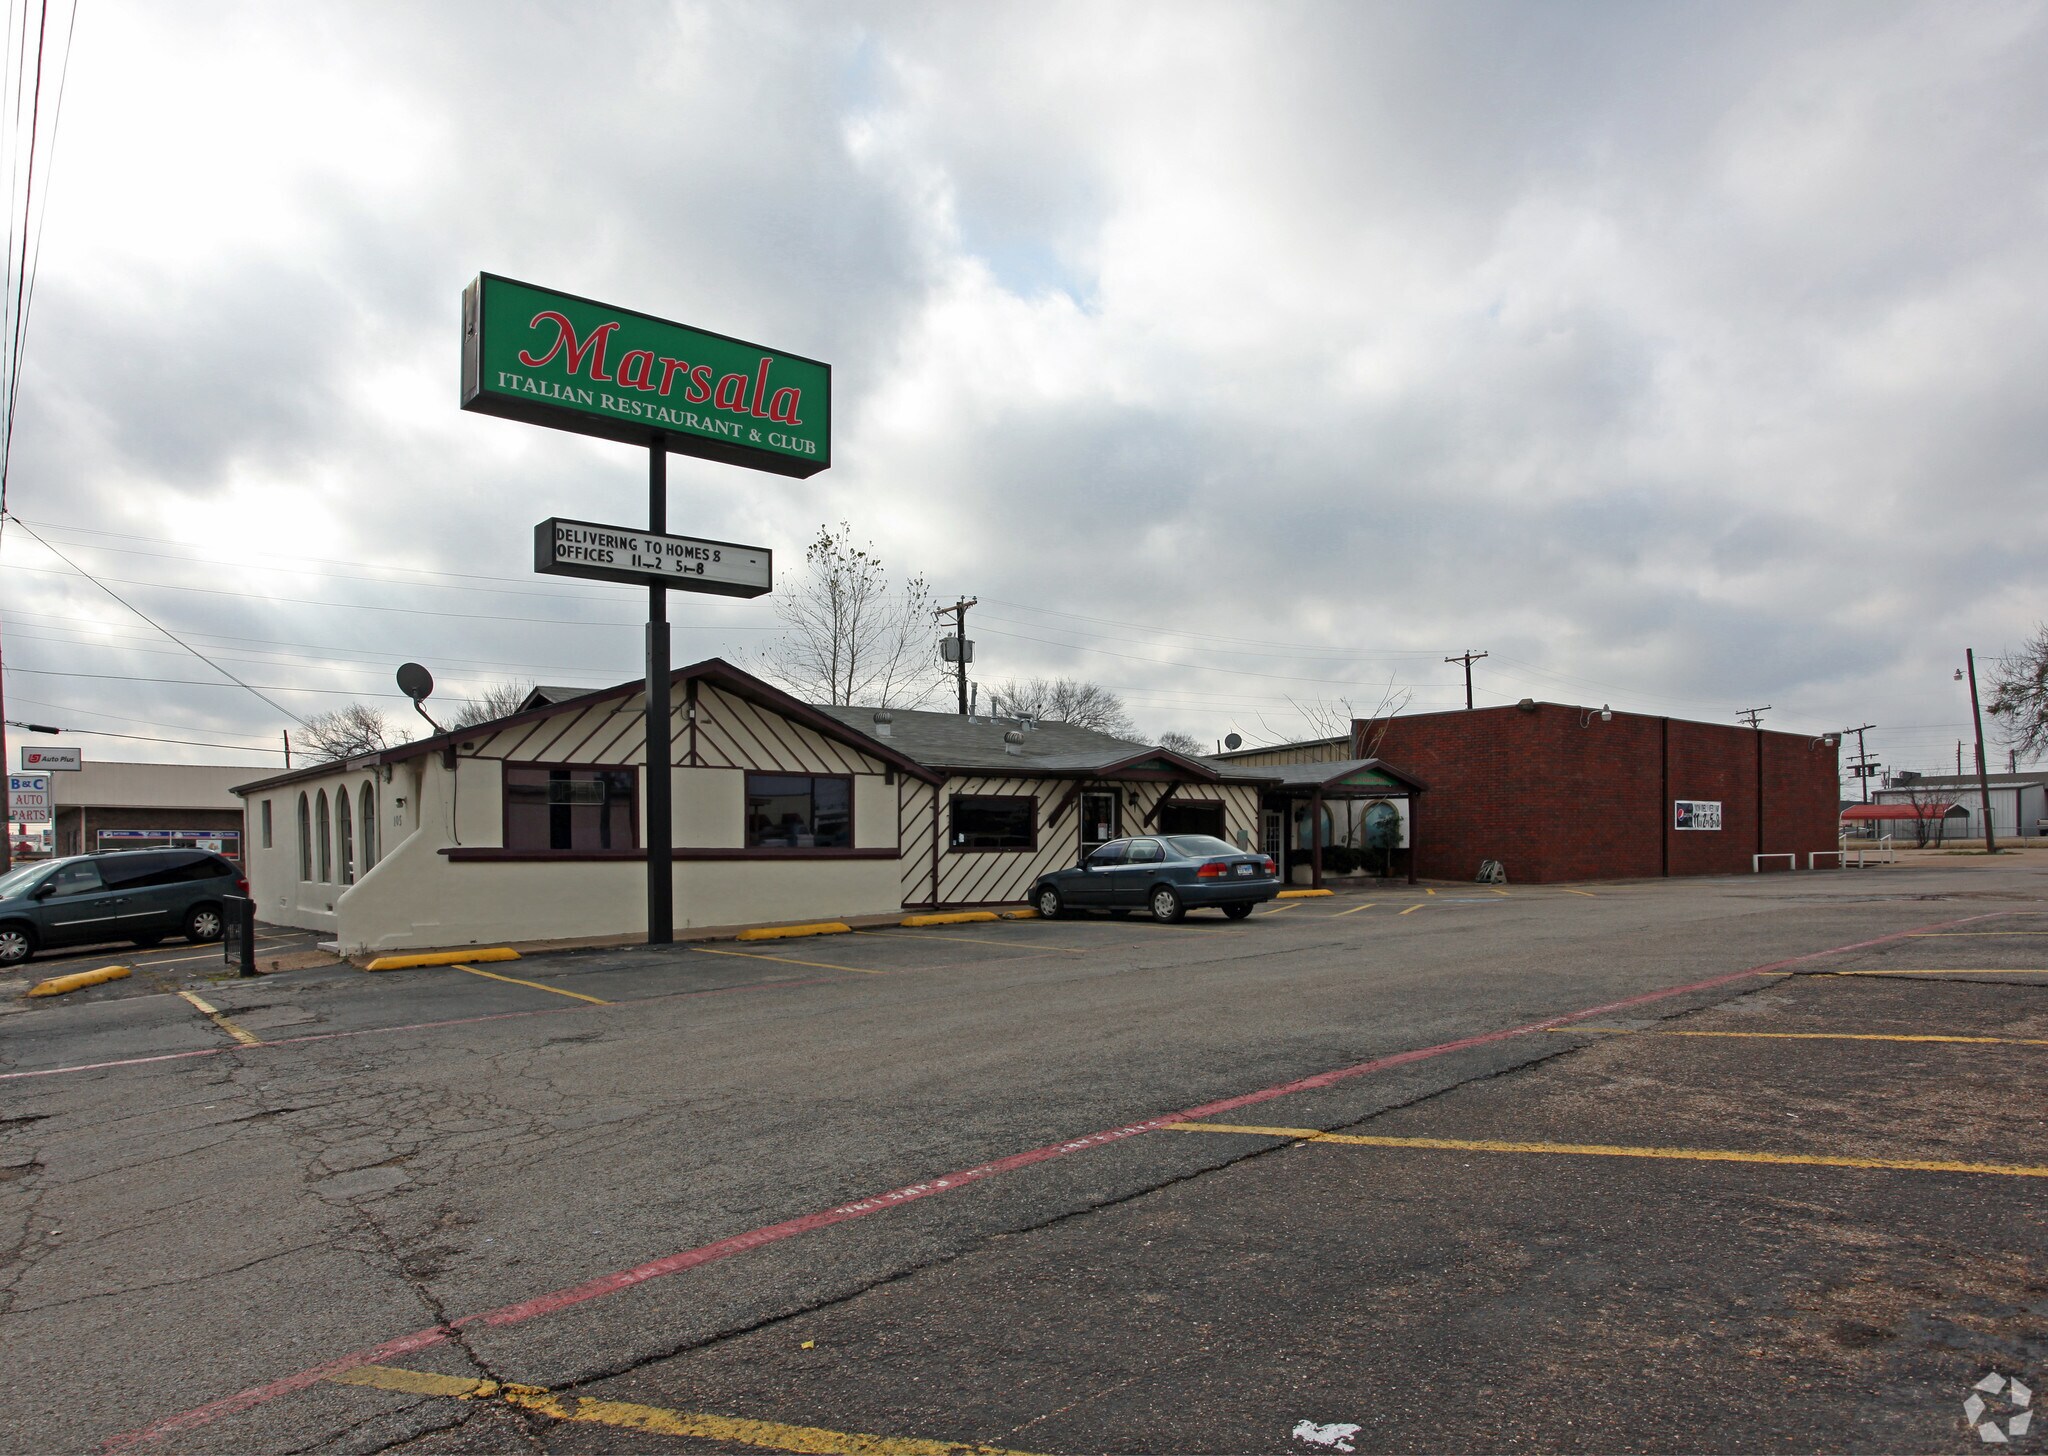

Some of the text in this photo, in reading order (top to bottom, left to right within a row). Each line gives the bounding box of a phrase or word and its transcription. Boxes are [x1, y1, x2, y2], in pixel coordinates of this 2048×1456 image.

[518, 310, 803, 426] Marsala
[498, 372, 816, 454] ITALIAN RESTAURANT & CLUB
[557, 528, 638, 551] DELIVERING
[645, 540, 662, 554] TO
[666, 543, 710, 562] HOMES
[557, 544, 614, 563] OFFICES
[12, 779, 43, 790] B & C
[16, 795, 43, 805] AUTO
[12, 810, 45, 820] PARTS
